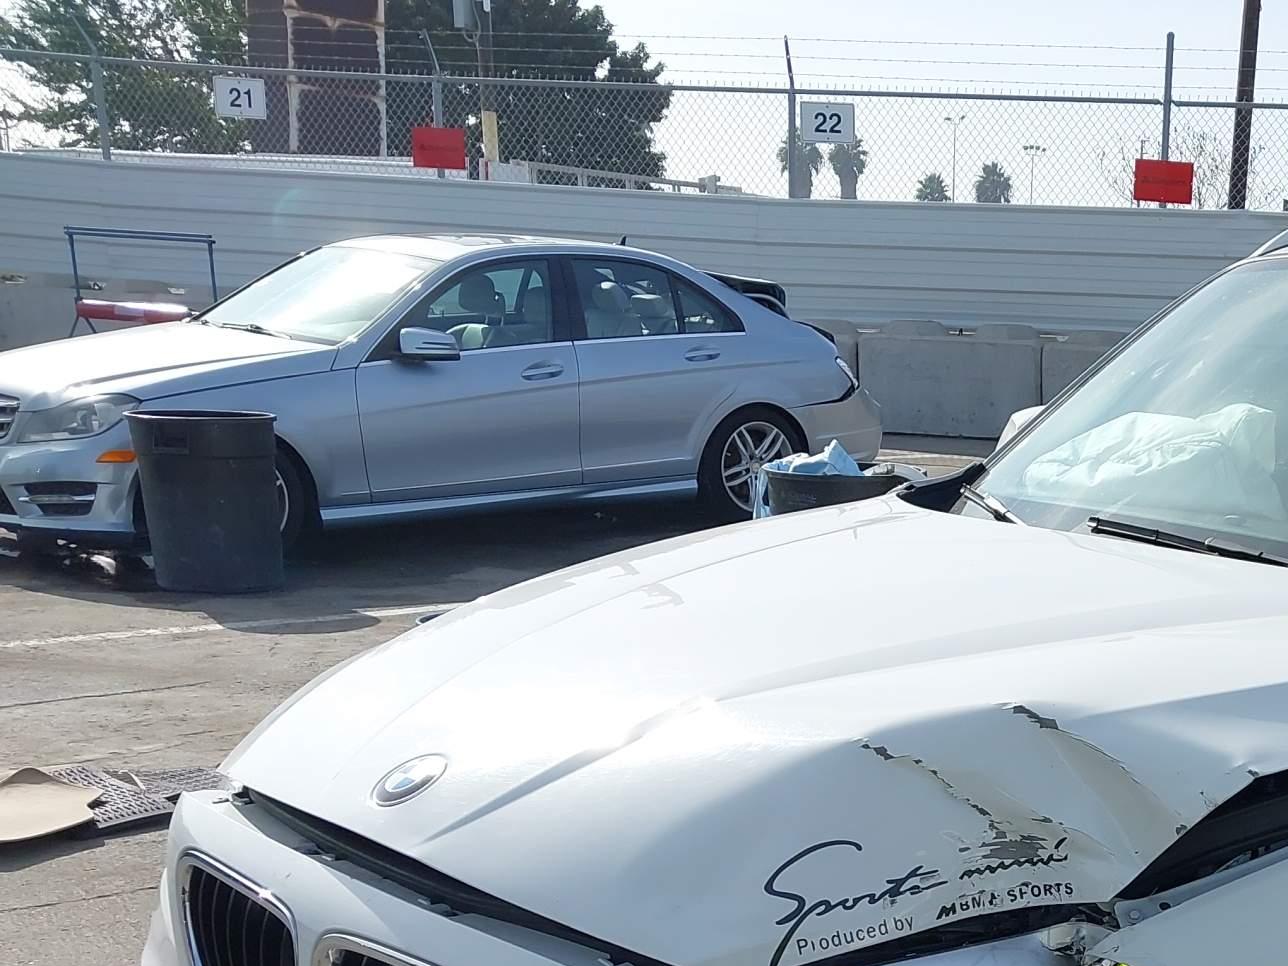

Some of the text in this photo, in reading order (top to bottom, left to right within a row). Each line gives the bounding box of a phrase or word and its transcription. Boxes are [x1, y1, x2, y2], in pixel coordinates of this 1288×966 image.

[229, 88, 252, 108] 21
[814, 112, 842, 133] 22
[796, 919, 888, 956] Produced
[892, 914, 914, 932] by
